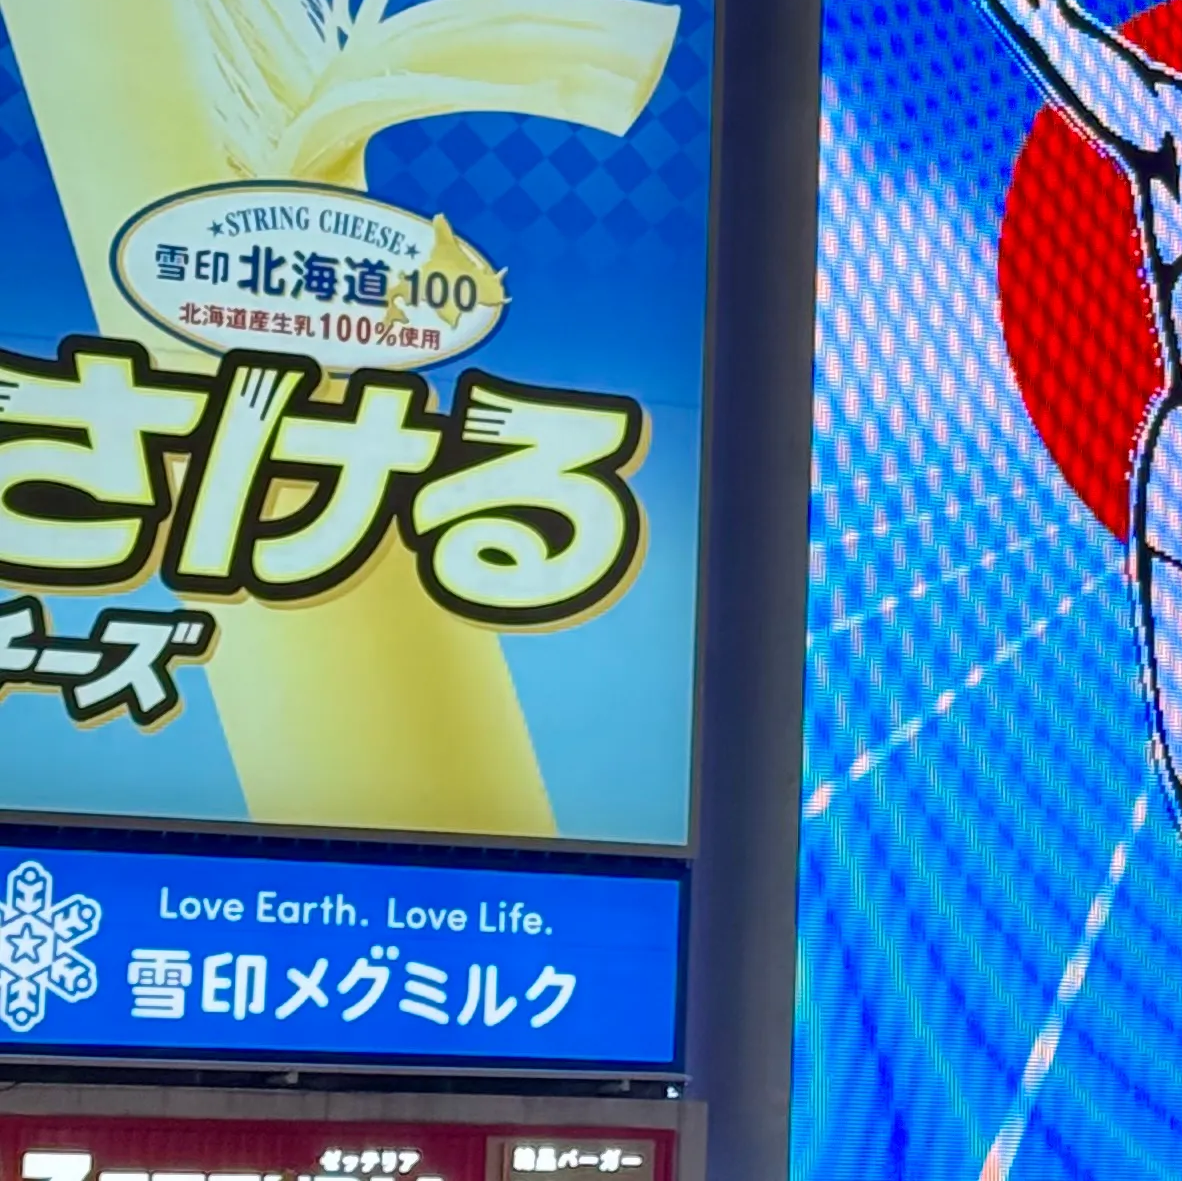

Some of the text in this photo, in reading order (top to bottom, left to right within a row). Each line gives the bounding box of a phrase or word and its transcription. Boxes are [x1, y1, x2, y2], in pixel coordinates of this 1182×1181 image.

[223, 205, 406, 257] STRING CHEESE
[178, 302, 442, 351] 北海道産生乳100%使用
[0, 348, 630, 611] さける
[158, 886, 554, 936] Love Earth. Love Life.
[126, 944, 578, 1029] 雪印メグミルク
